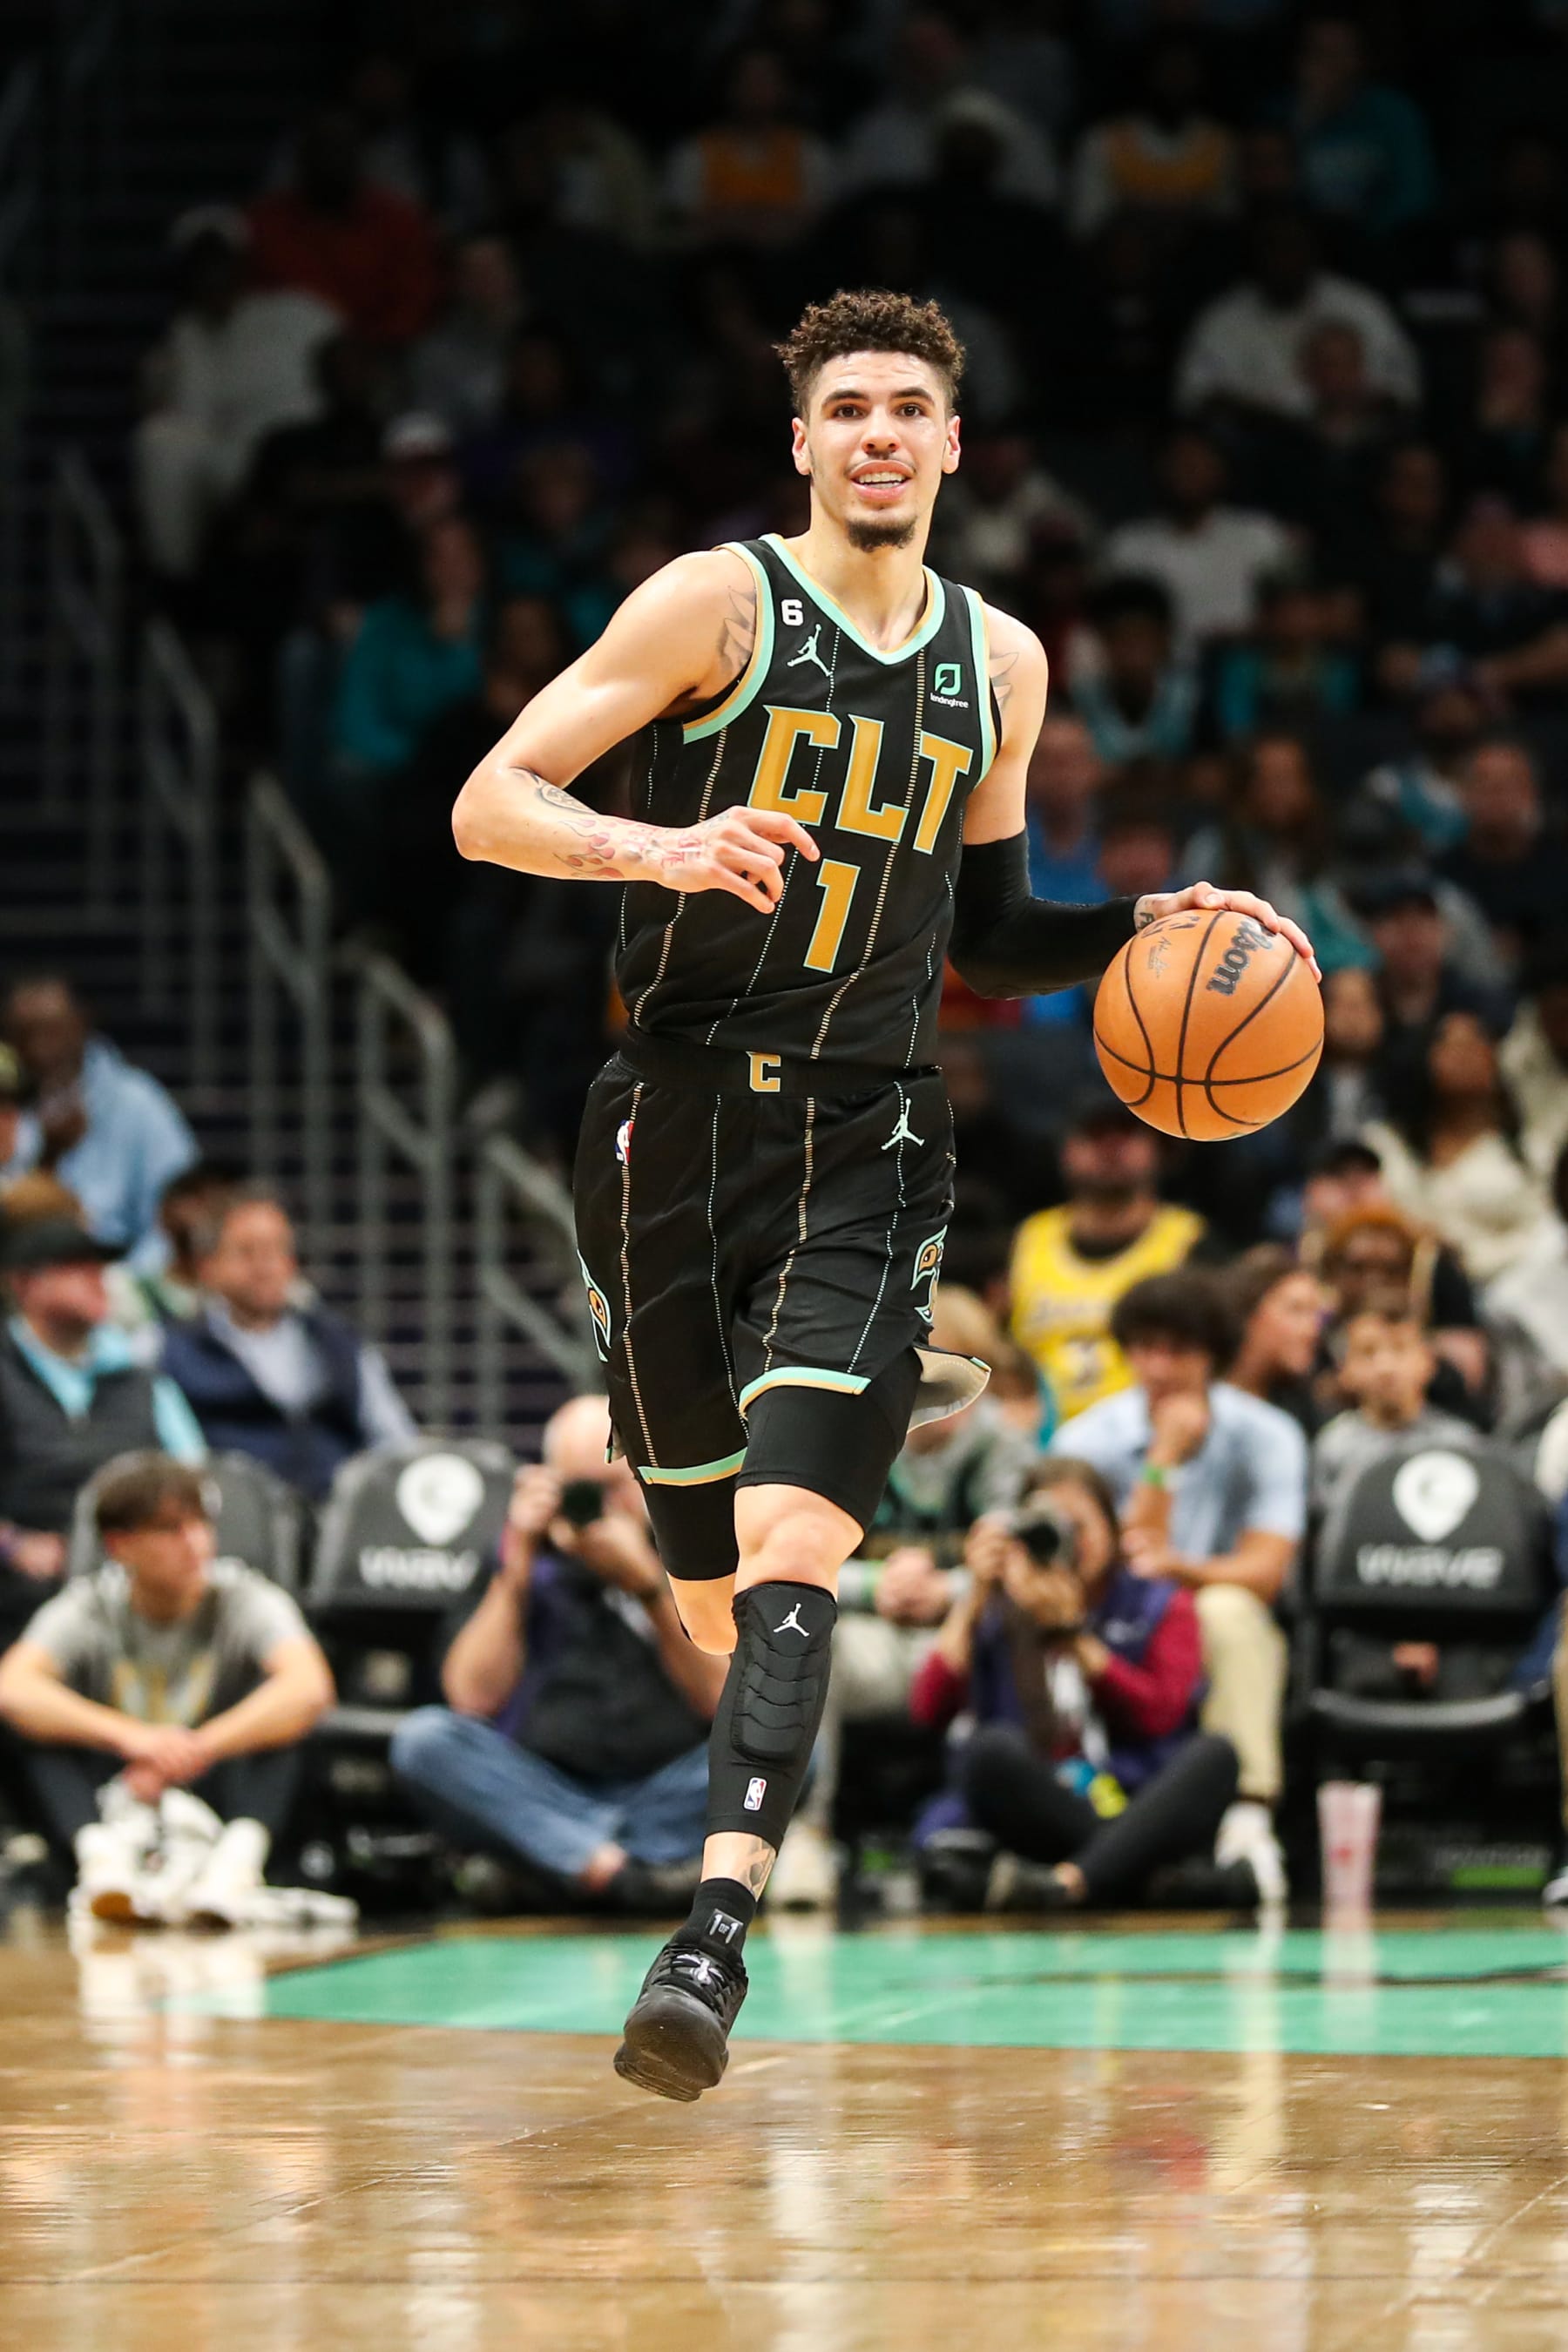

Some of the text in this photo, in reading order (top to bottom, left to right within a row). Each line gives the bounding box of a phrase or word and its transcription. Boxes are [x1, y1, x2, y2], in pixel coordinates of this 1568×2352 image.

[781, 598, 804, 626] 6
[747, 705, 974, 855] CLT
[803, 858, 861, 974] 1
[745, 1051, 781, 1092] C
[709, 1914, 723, 1936] 1
[725, 1923, 739, 1944] 1
